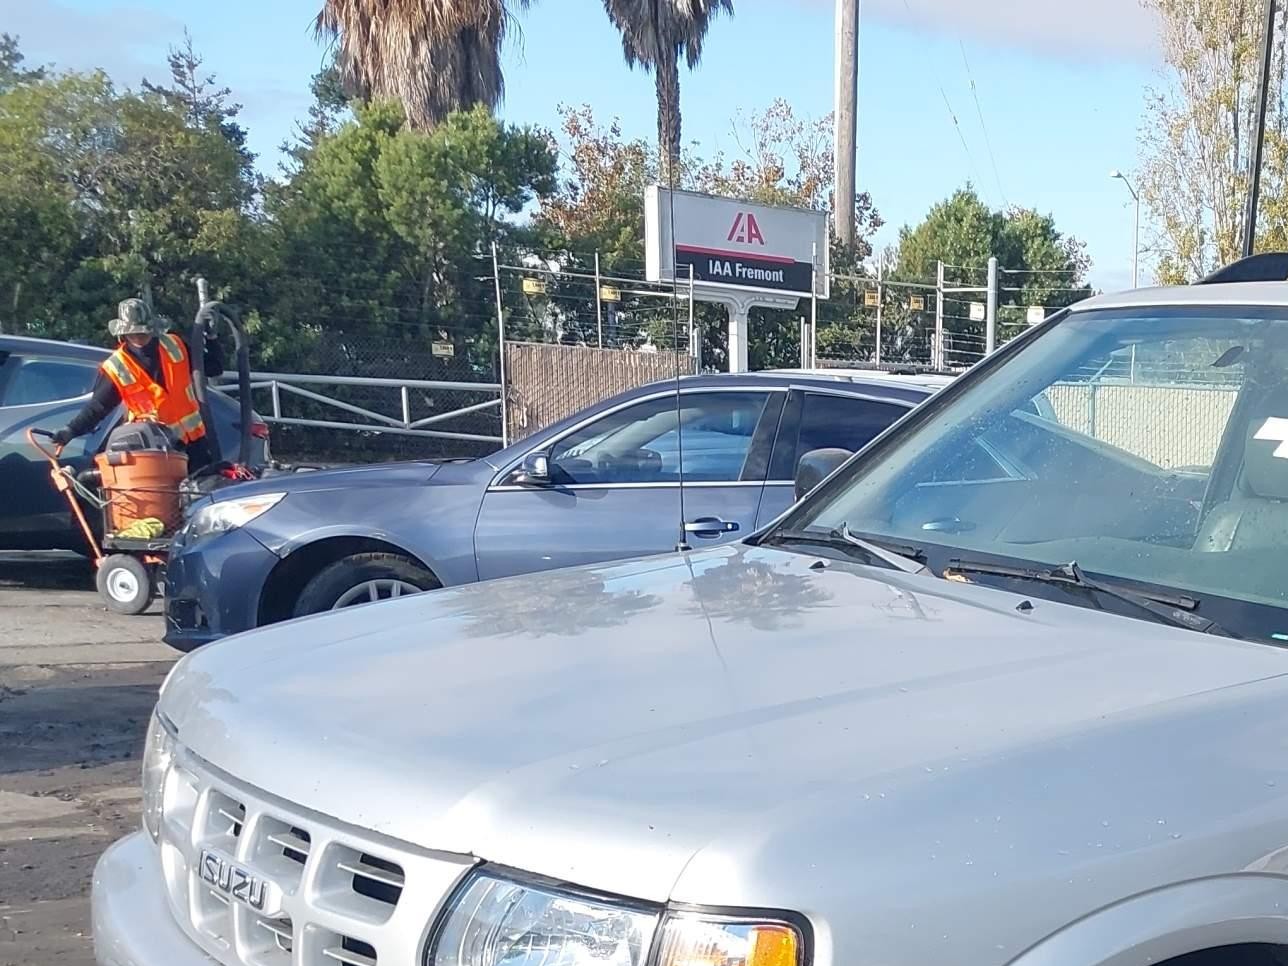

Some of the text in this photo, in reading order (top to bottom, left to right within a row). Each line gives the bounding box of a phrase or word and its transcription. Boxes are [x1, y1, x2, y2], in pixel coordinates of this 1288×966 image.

[709, 259, 785, 283] IAA Fremont
[200, 850, 269, 910] ISUZU
